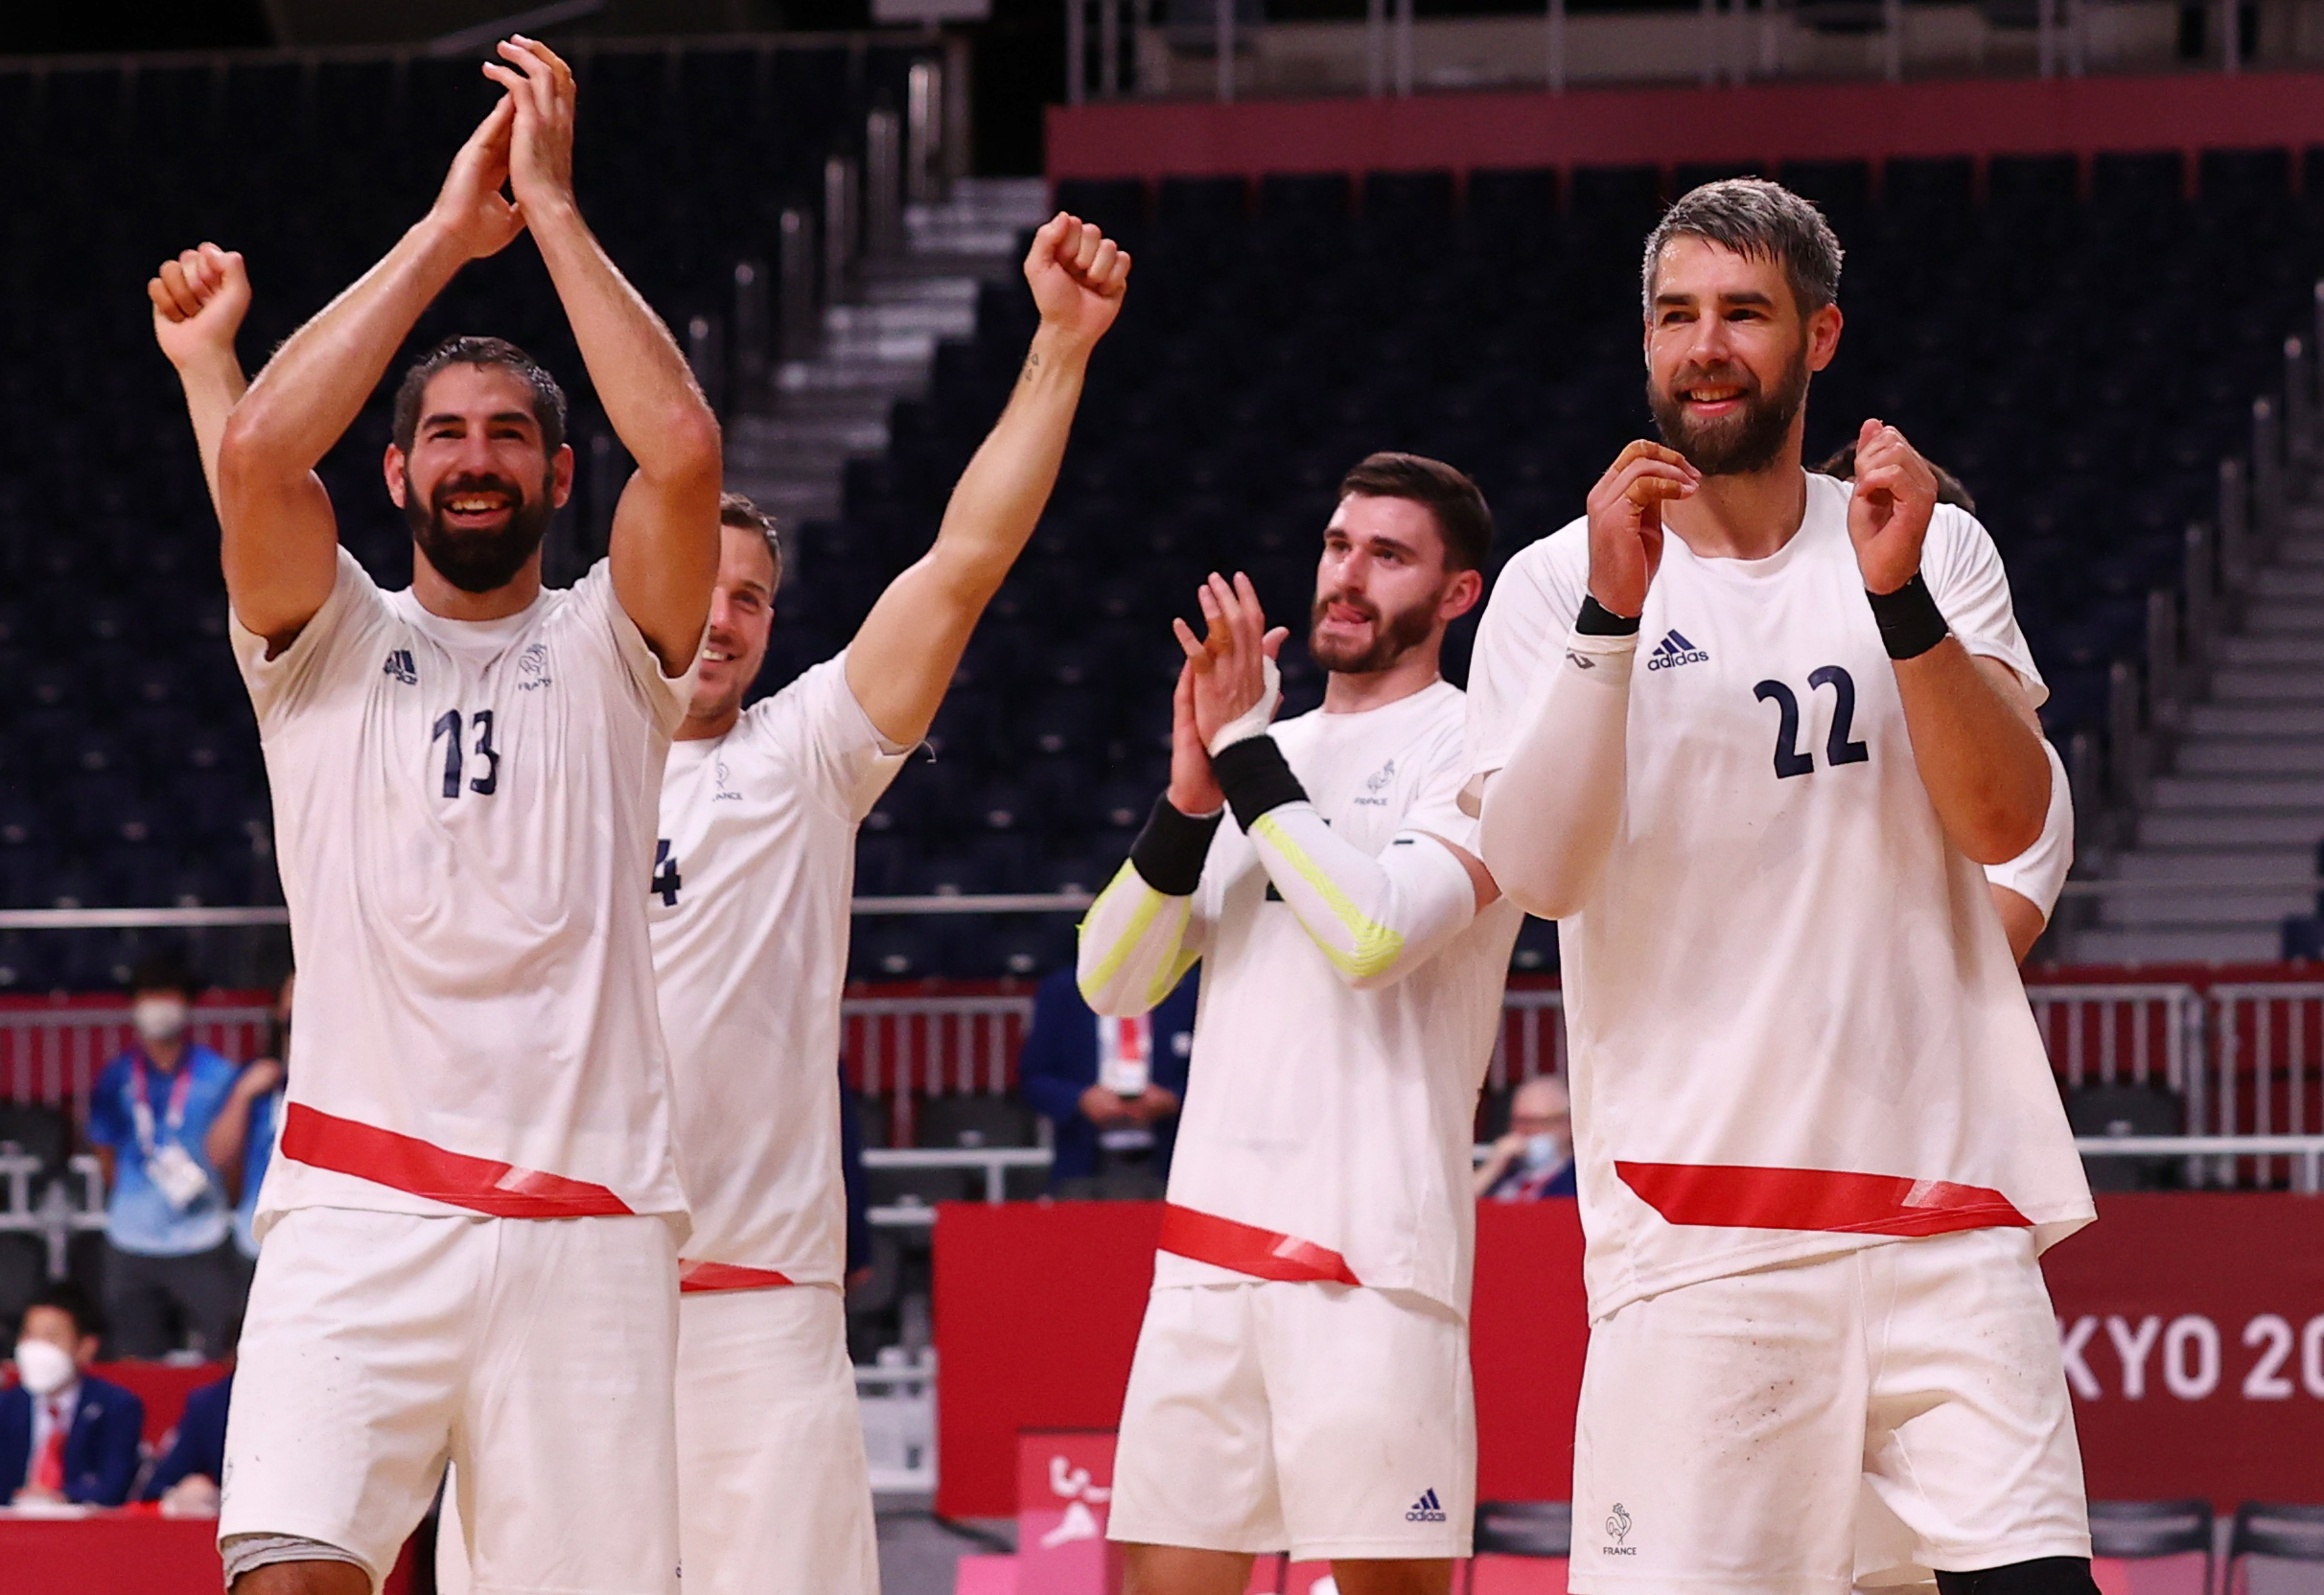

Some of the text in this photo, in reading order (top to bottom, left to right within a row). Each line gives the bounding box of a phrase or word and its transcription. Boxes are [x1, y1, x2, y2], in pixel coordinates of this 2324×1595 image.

[1647, 648, 1709, 672] adidas
[1753, 665, 1870, 779] 22
[431, 708, 500, 799] 13
[651, 838, 682, 907] 4
[1406, 1509, 1447, 1522] adidas
[1602, 1546, 1638, 1556] FRANCE
